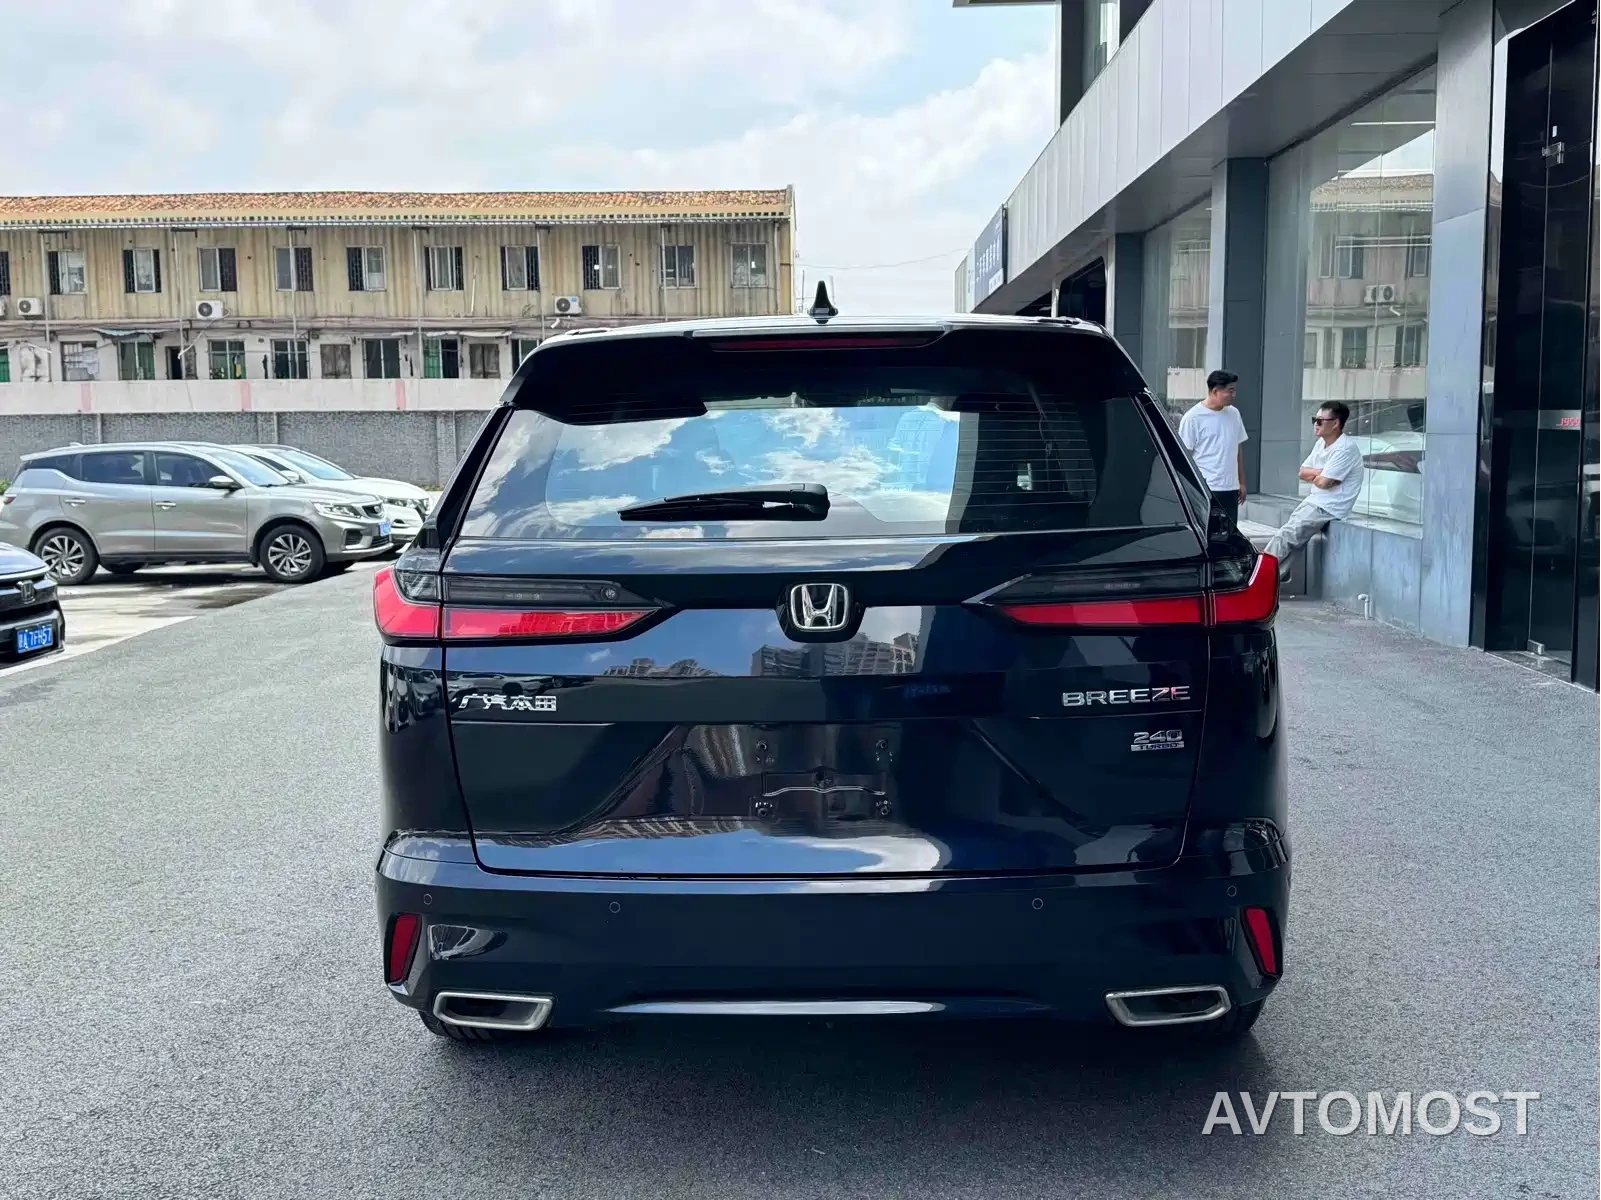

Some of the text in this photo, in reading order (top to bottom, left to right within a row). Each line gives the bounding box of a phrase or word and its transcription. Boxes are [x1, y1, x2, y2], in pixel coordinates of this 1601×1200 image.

[456, 694, 557, 712] 广汽本田
[1062, 685, 1191, 706] BREEZE
[1133, 730, 1182, 744] 240
[1137, 742, 1181, 751] TURBO
